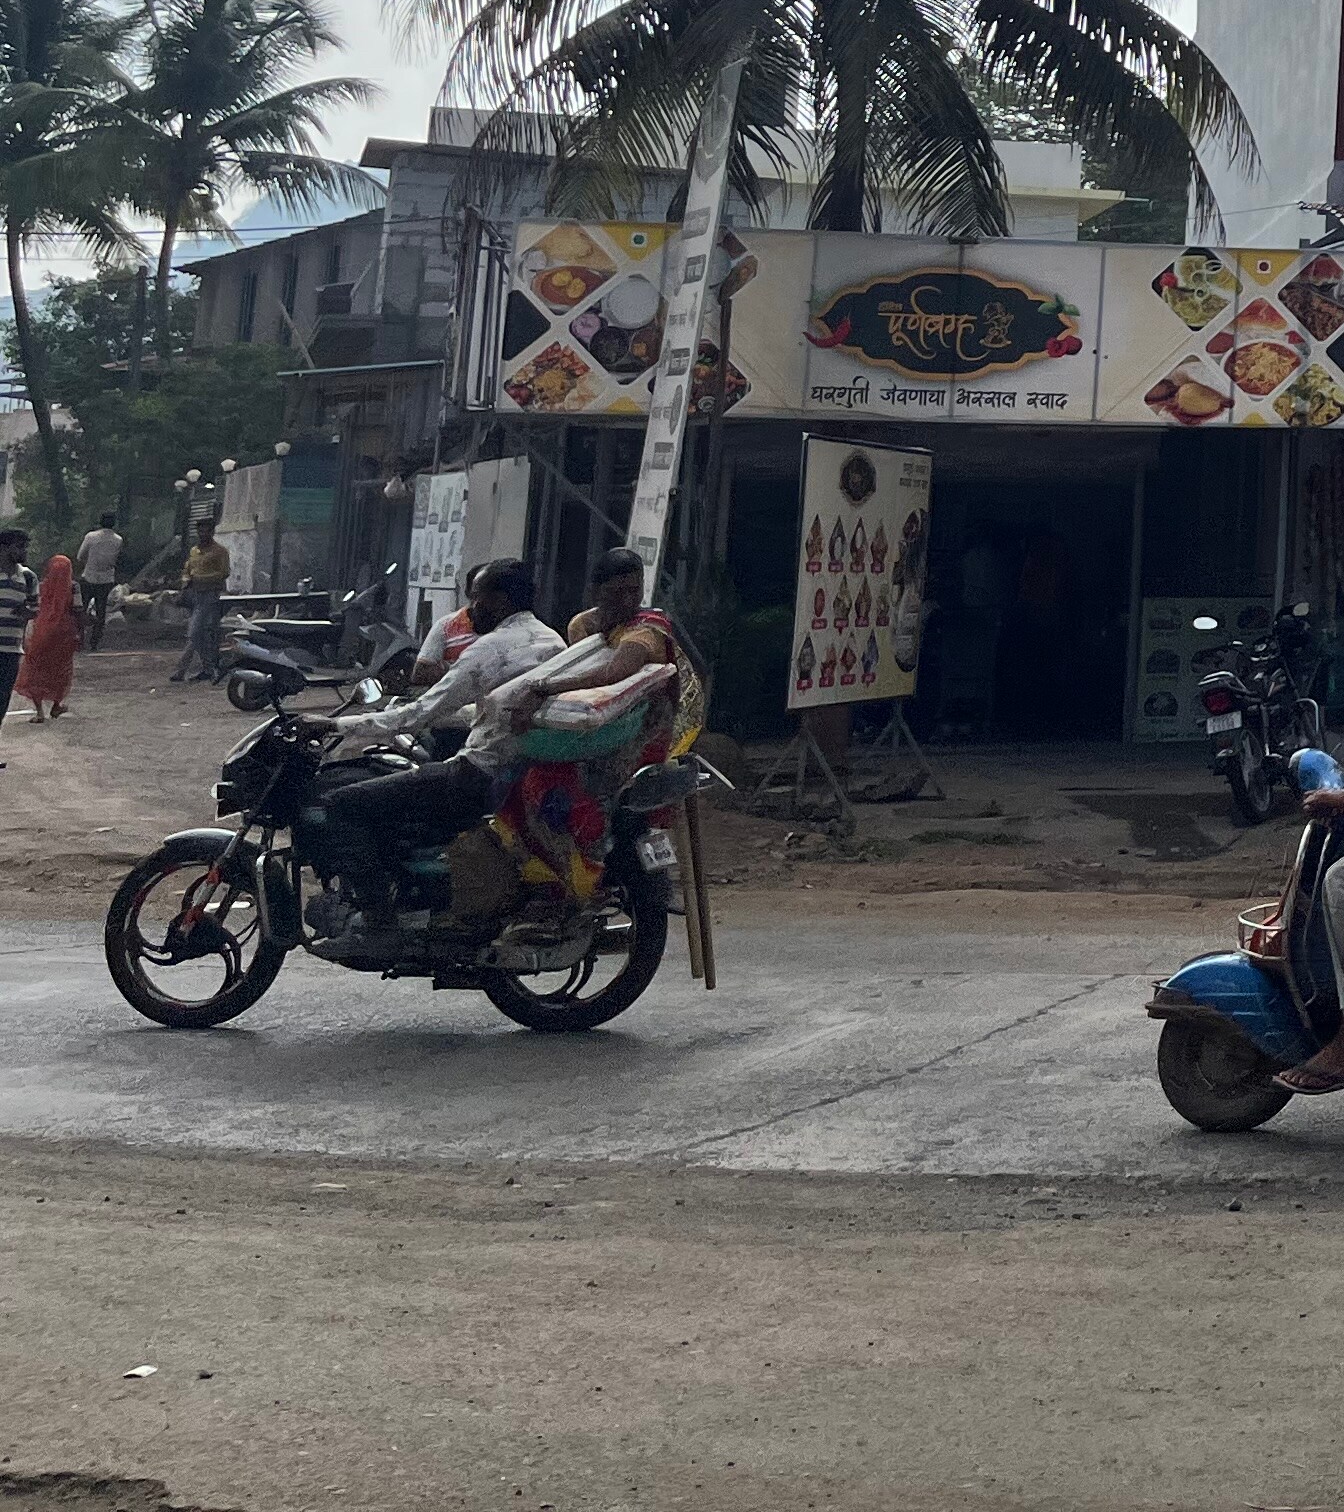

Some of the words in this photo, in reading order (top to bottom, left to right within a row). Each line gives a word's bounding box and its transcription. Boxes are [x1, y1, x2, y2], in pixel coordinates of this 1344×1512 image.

[811, 376, 870, 409] घरगुती
[956, 388, 1016, 408] अस्सल
[1027, 392, 1068, 410] स्वाद
